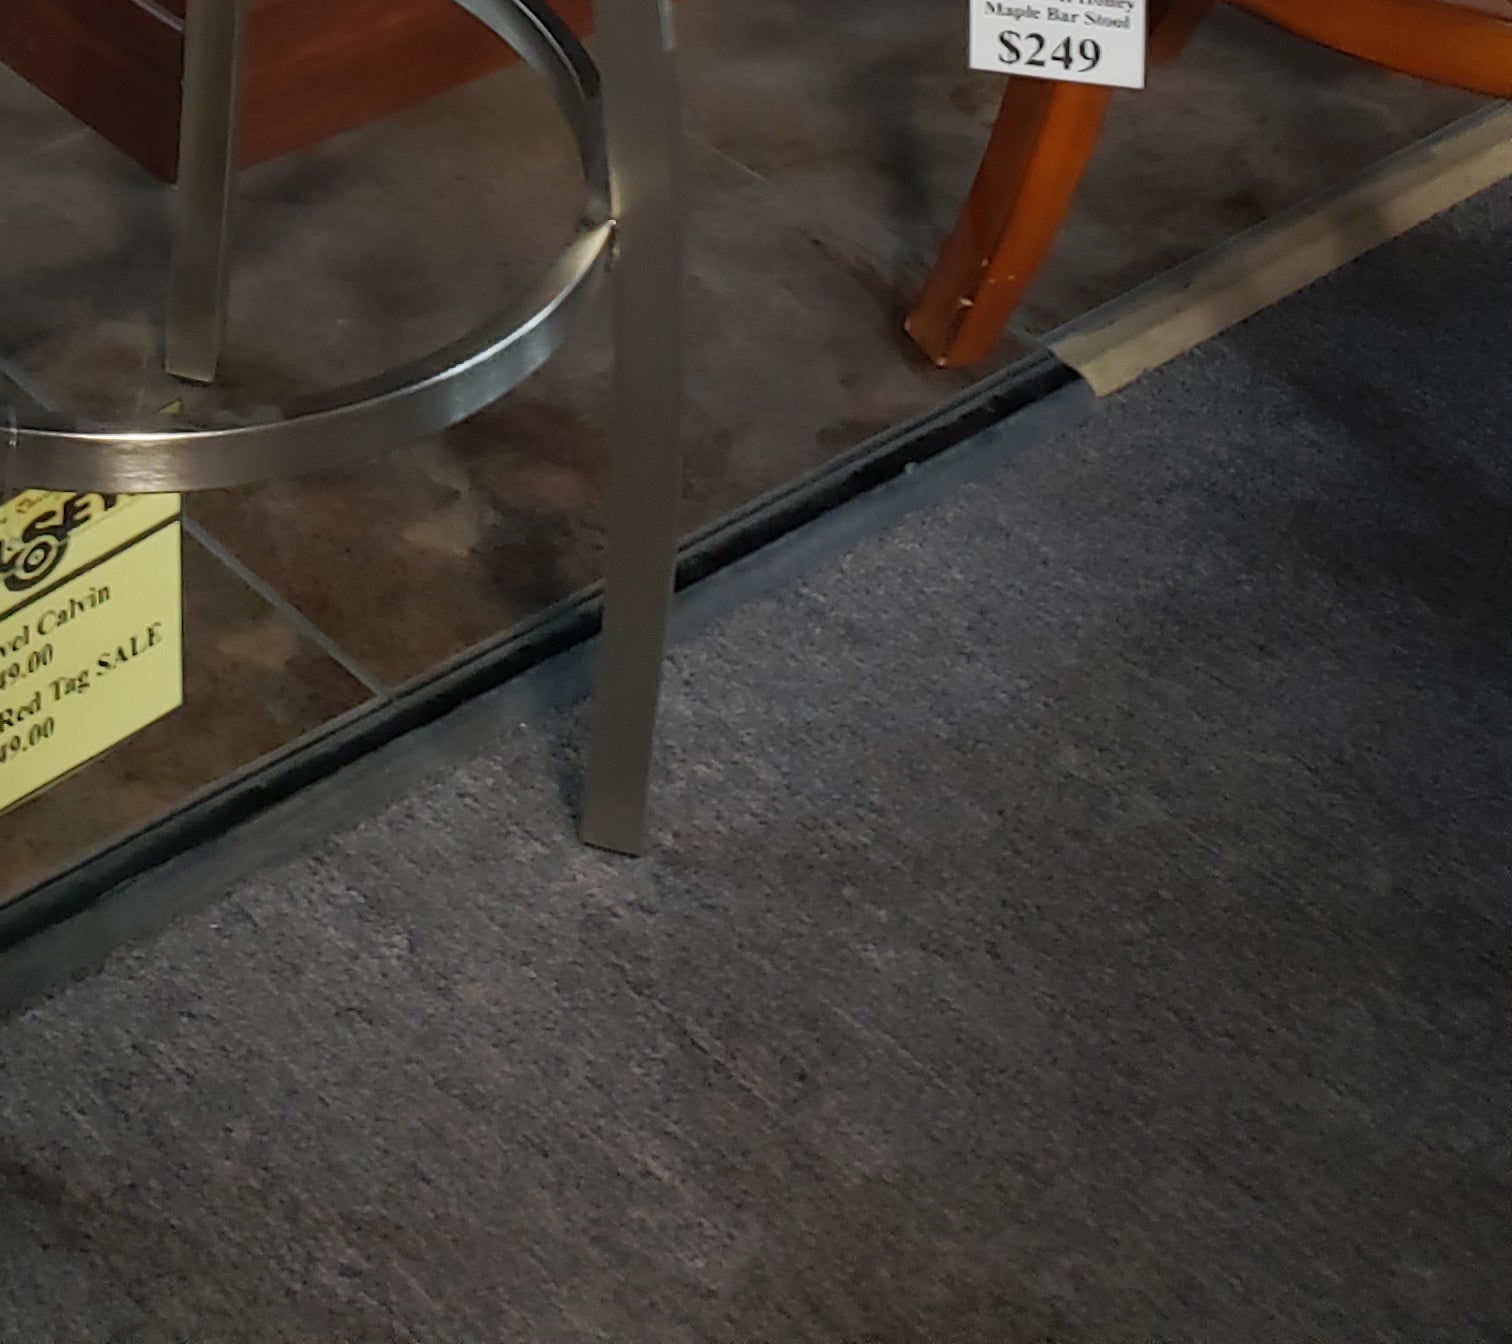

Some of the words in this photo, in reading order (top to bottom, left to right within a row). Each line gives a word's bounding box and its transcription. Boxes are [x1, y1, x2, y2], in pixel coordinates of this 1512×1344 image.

[985, 1, 1040, 21] Maple
[1047, 7, 1079, 23] Bar
[1084, 11, 1131, 29] Stool
[998, 30, 1101, 73] $249
[37, 585, 112, 636] Calvin
[49, 669, 91, 701] Tag
[95, 621, 163, 676] SALE
